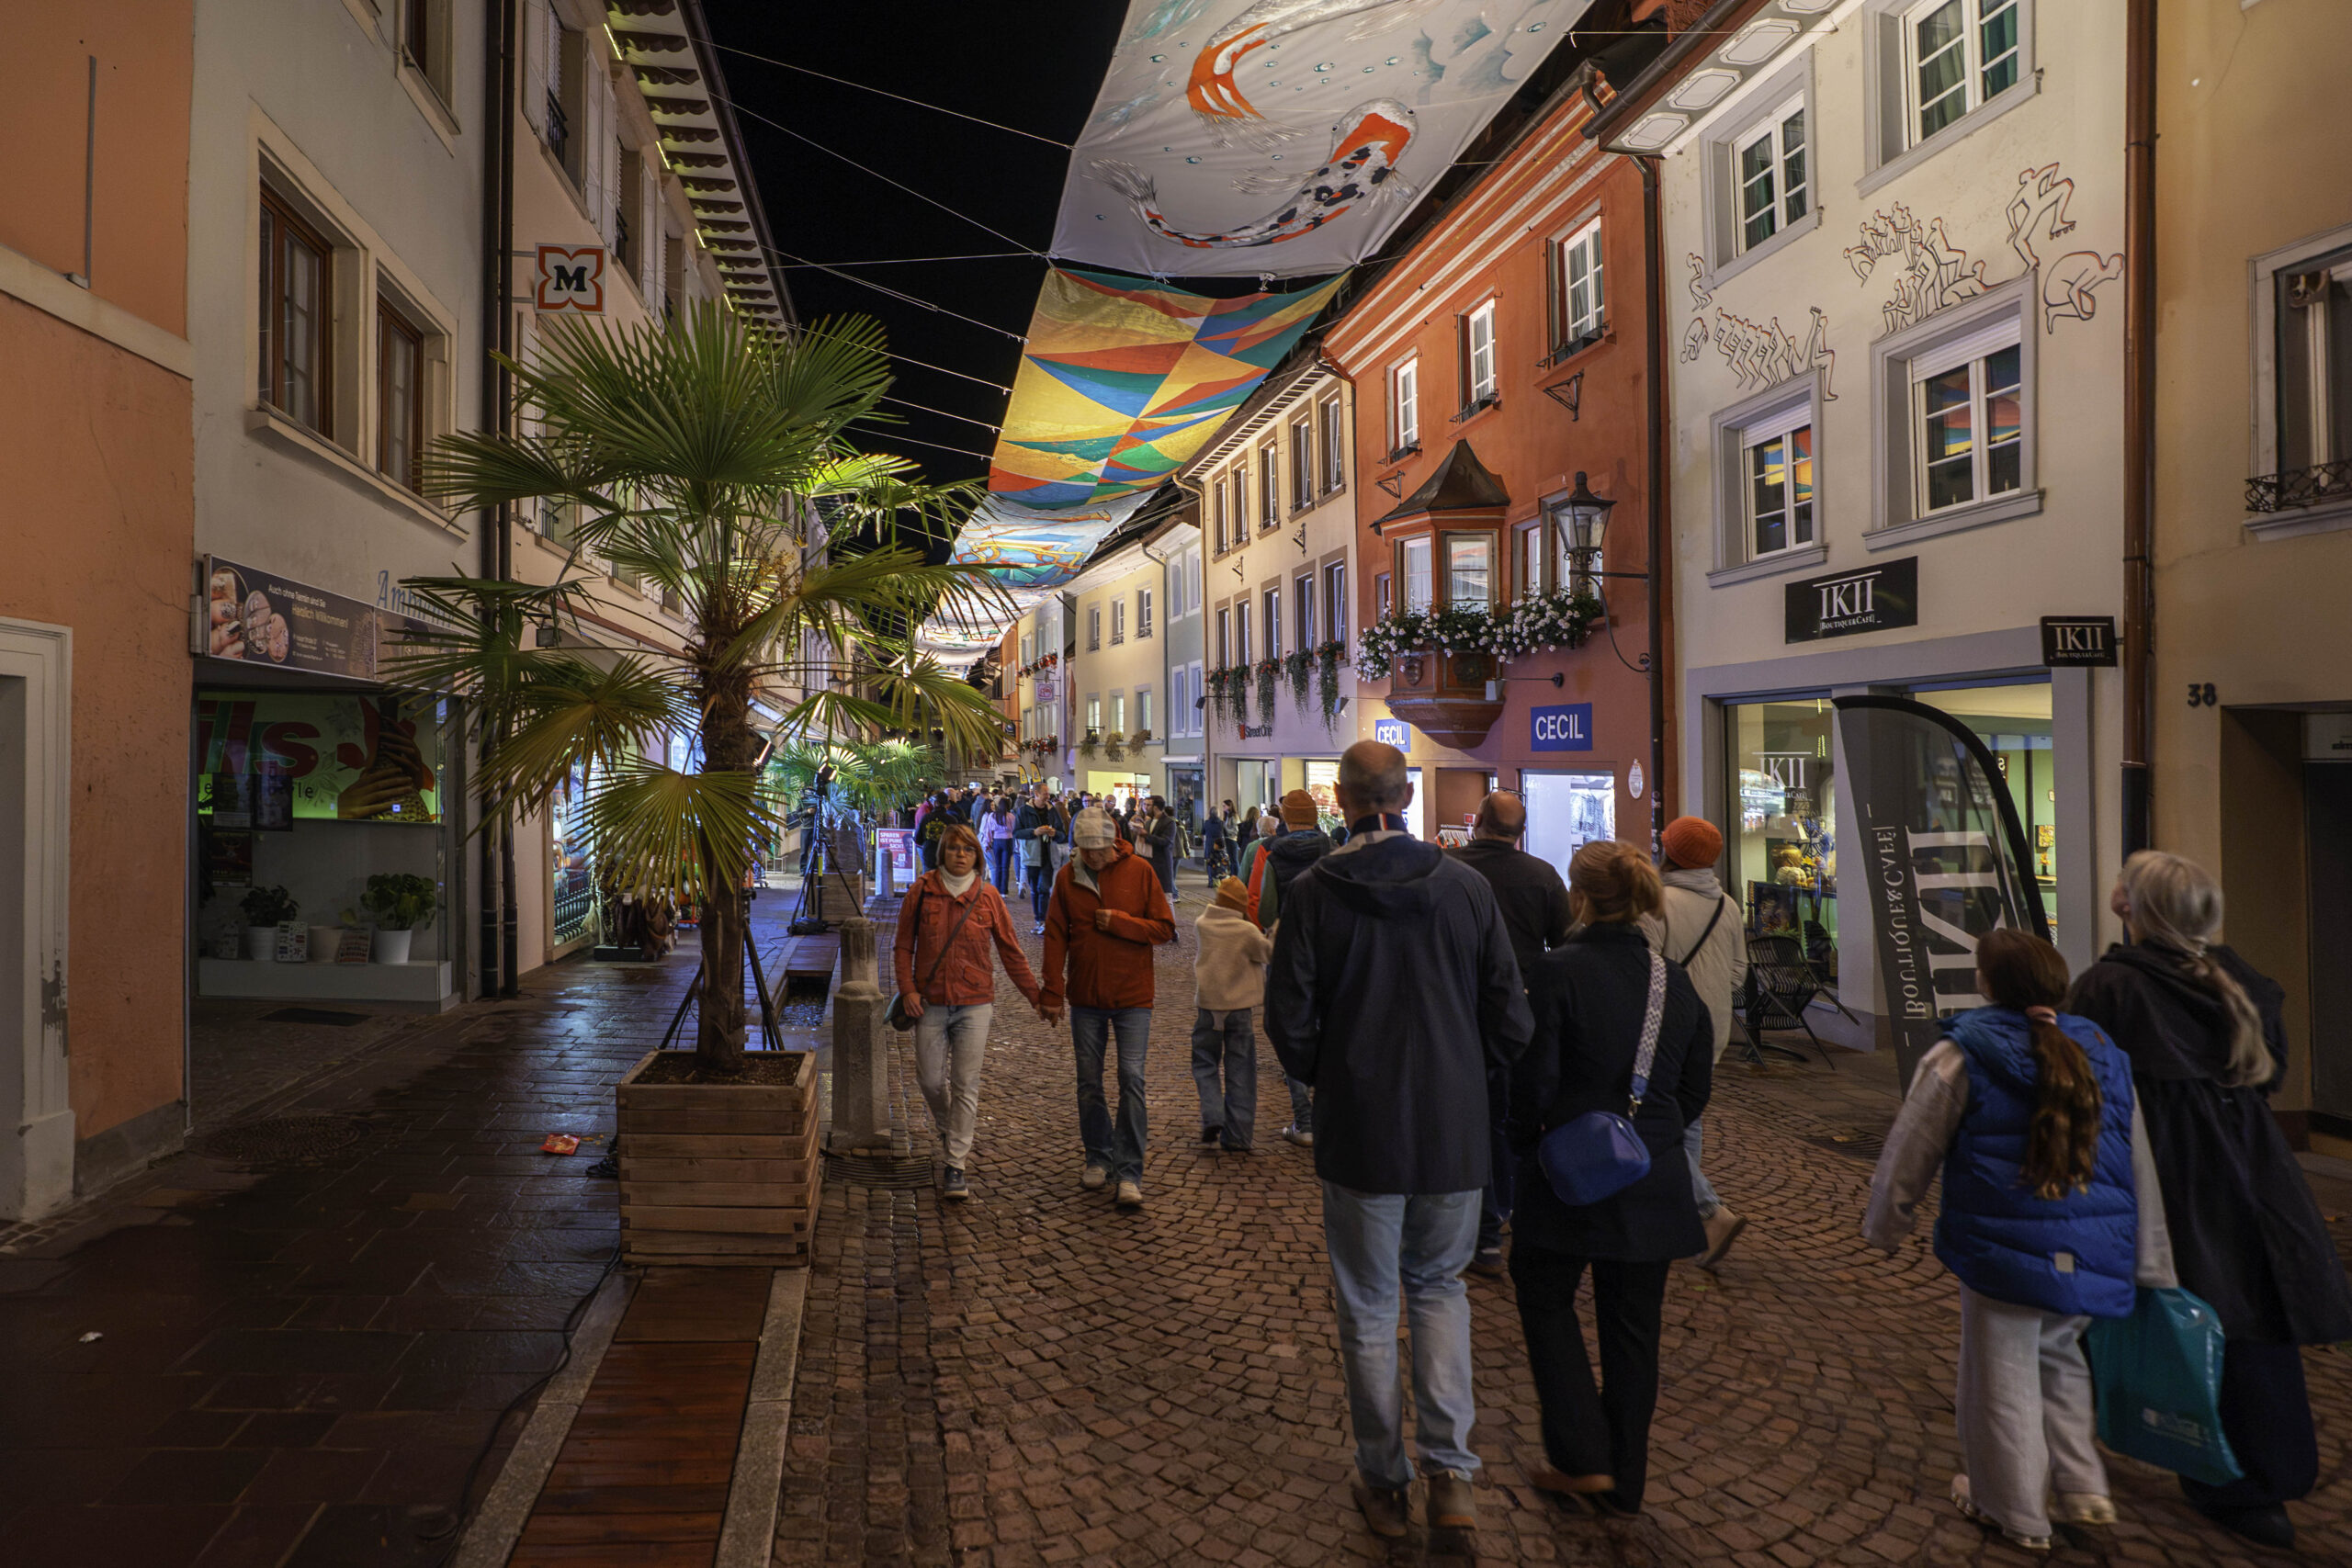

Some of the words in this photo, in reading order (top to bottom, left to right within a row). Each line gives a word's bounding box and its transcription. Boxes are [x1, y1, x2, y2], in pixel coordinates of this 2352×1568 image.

[553, 265, 587, 291] M
[1820, 578, 1875, 620] IKII
[2055, 626, 2104, 650] IKII
[2188, 682, 2216, 706] 38
[1377, 725, 1406, 745] CECIL
[1535, 714, 1584, 740] CECIL
[1759, 757, 1807, 788] IKII
